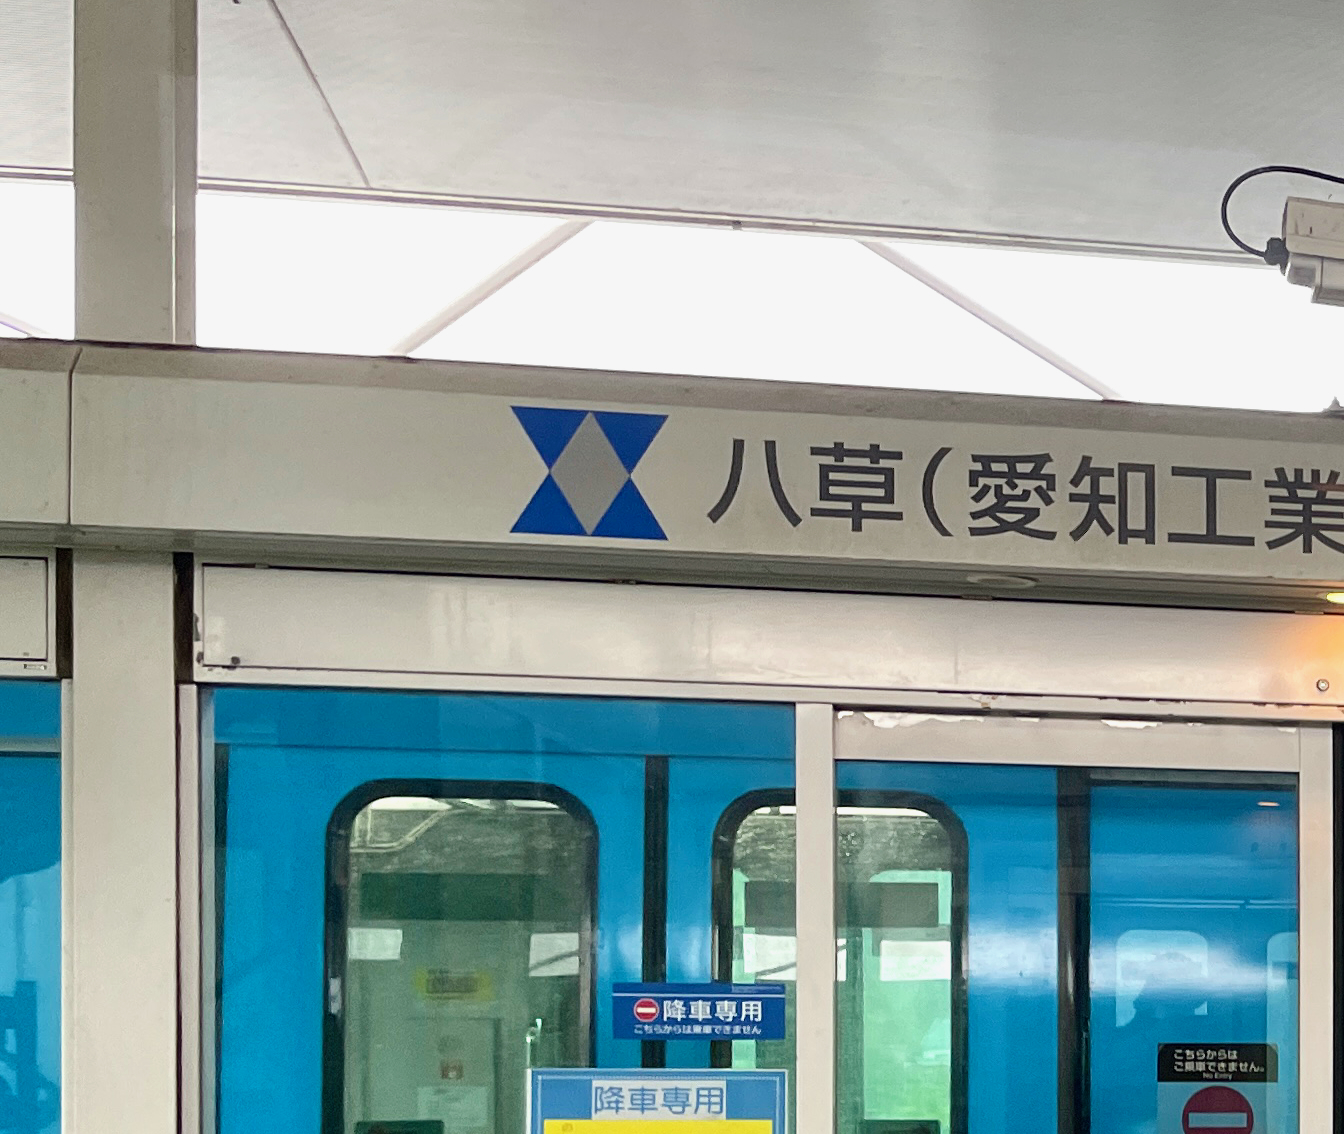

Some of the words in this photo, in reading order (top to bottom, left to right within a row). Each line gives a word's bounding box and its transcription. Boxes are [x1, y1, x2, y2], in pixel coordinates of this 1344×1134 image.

[663, 999, 763, 1022] 降車専用
[1174, 1049, 1238, 1060] こちらからは
[594, 1086, 724, 1115] 降車専用
